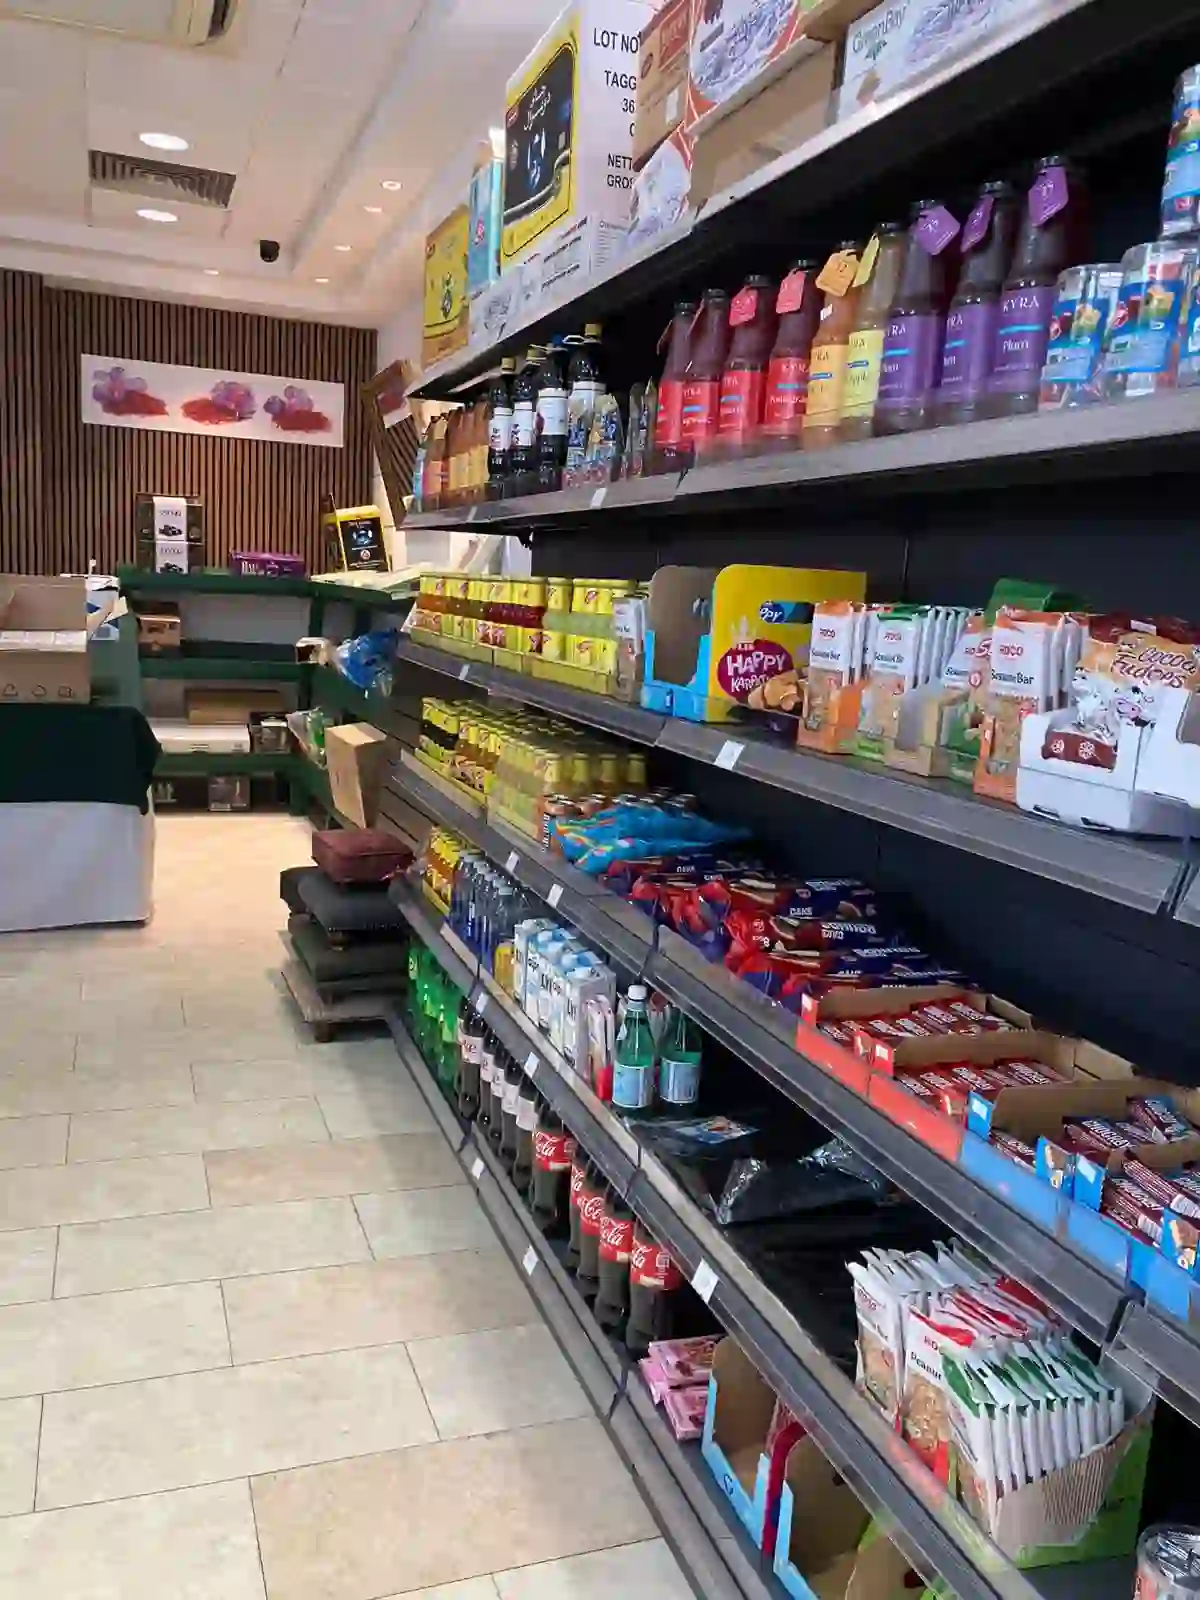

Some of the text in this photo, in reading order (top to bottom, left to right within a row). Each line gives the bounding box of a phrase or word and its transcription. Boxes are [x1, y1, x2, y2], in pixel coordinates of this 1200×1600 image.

[593, 28, 639, 54] LOT NO
[1002, 295, 1040, 313] KYRA
[726, 651, 786, 677] HAPPY
[1016, 671, 1035, 685] Bar
